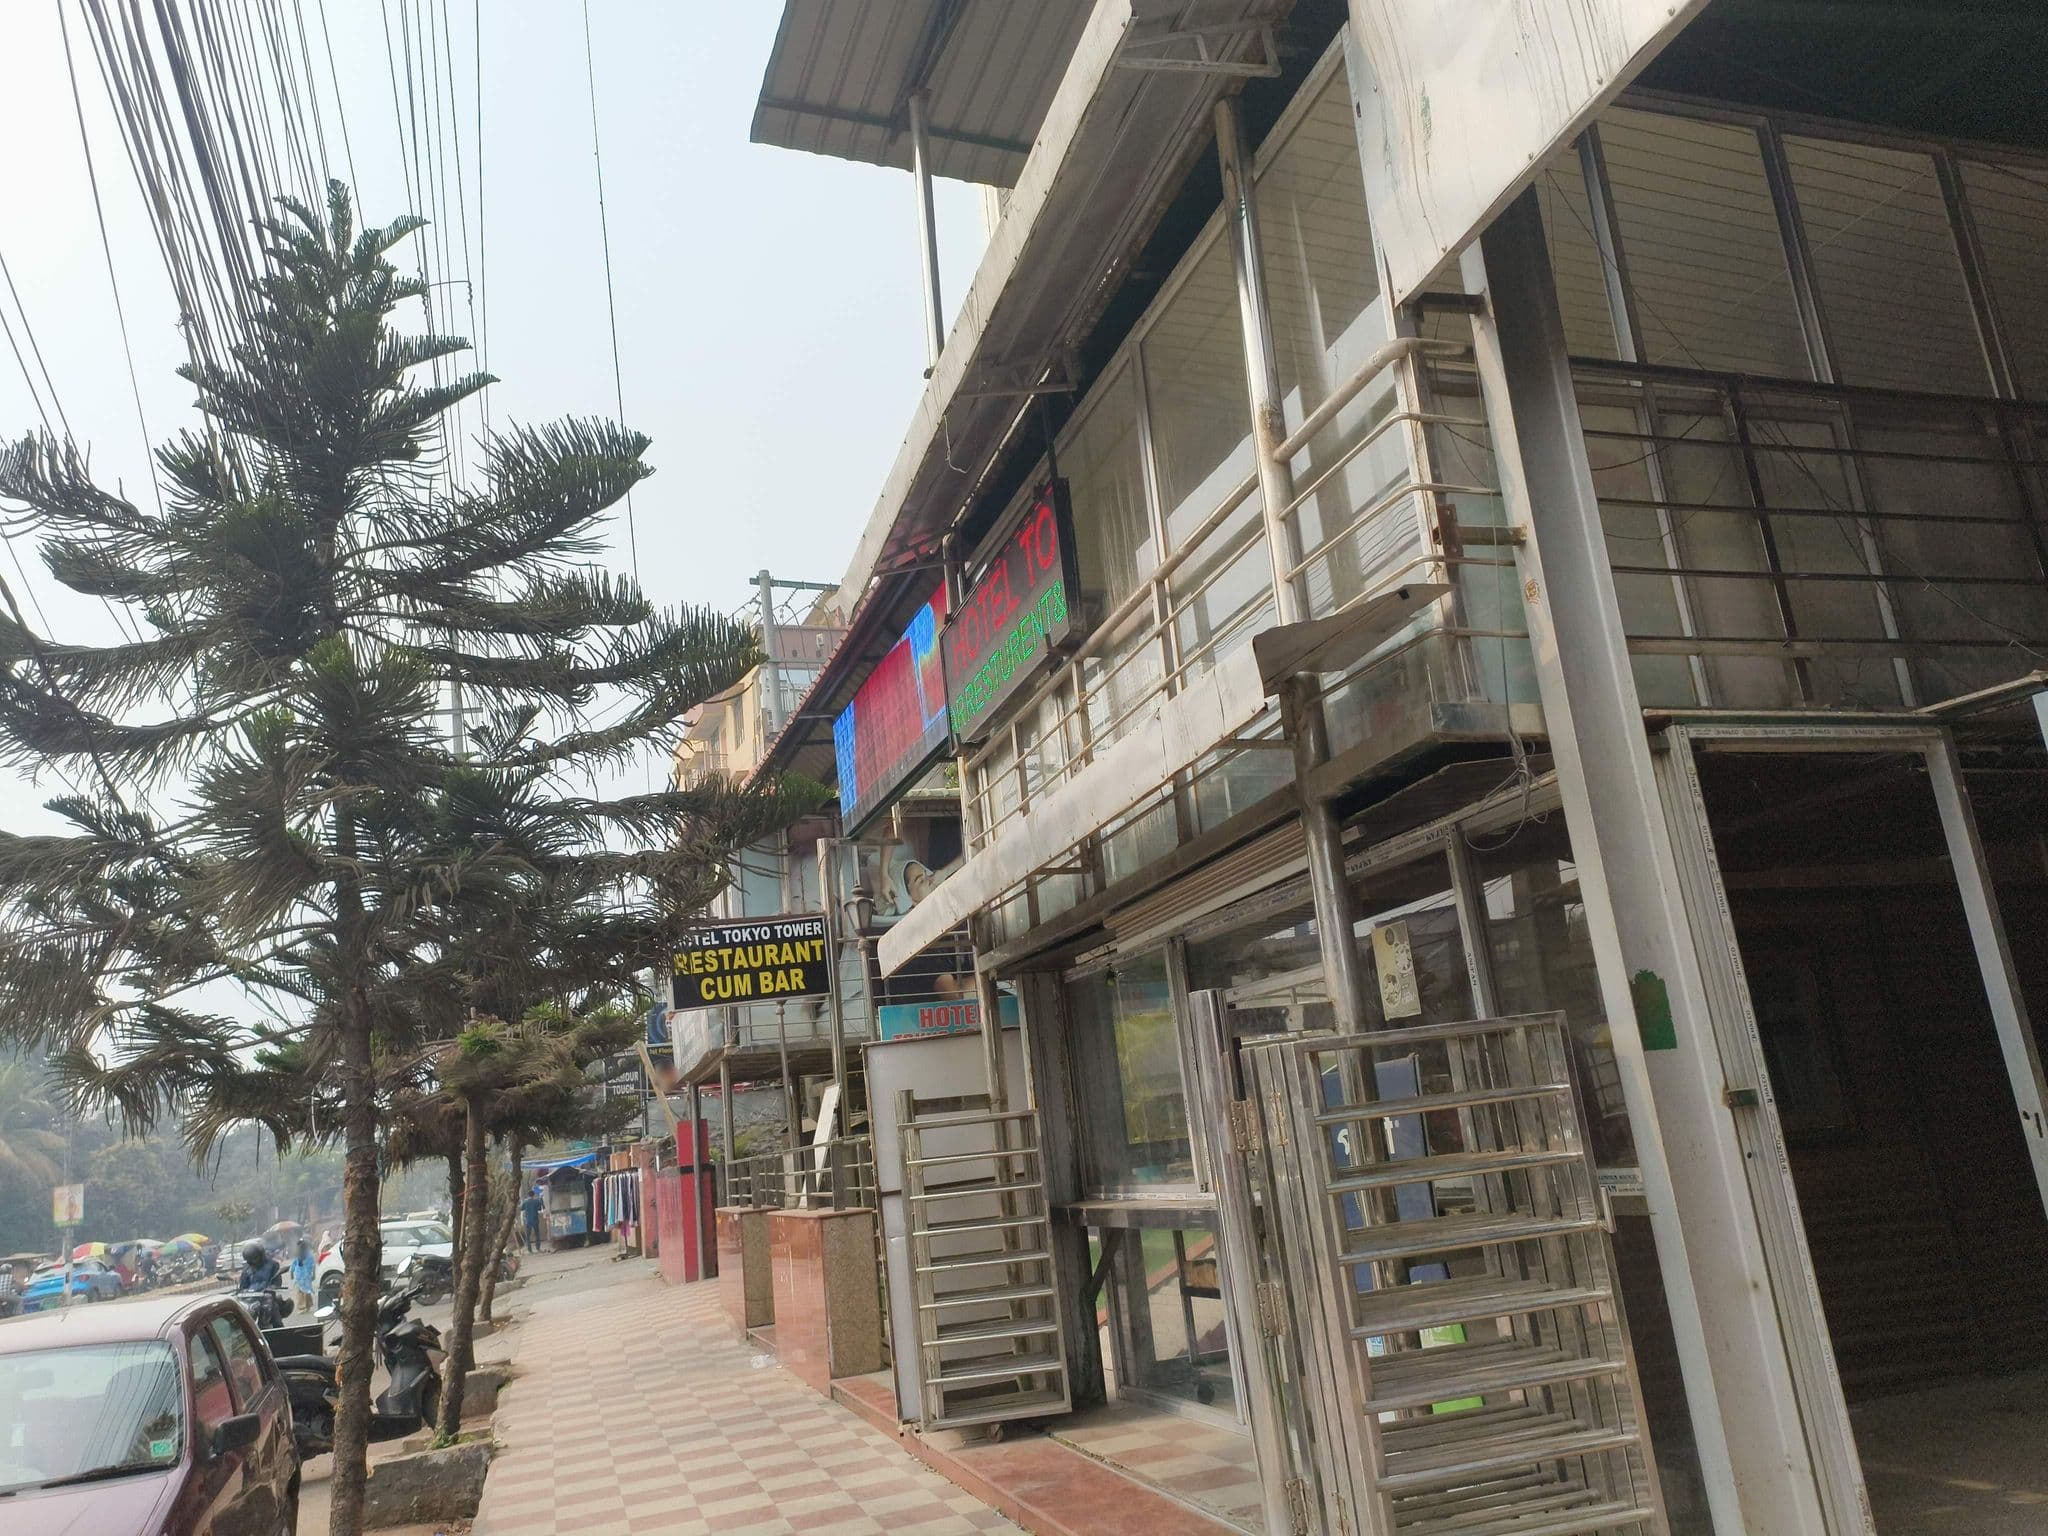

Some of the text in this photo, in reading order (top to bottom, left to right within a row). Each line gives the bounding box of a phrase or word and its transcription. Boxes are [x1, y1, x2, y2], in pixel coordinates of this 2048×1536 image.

[951, 505, 1055, 678] HOTEL TO
[723, 926, 771, 944] TOKYO
[774, 921, 823, 939] TOWER
[673, 939, 825, 976] RESTAURANT
[700, 968, 806, 1001] CUM BAR
